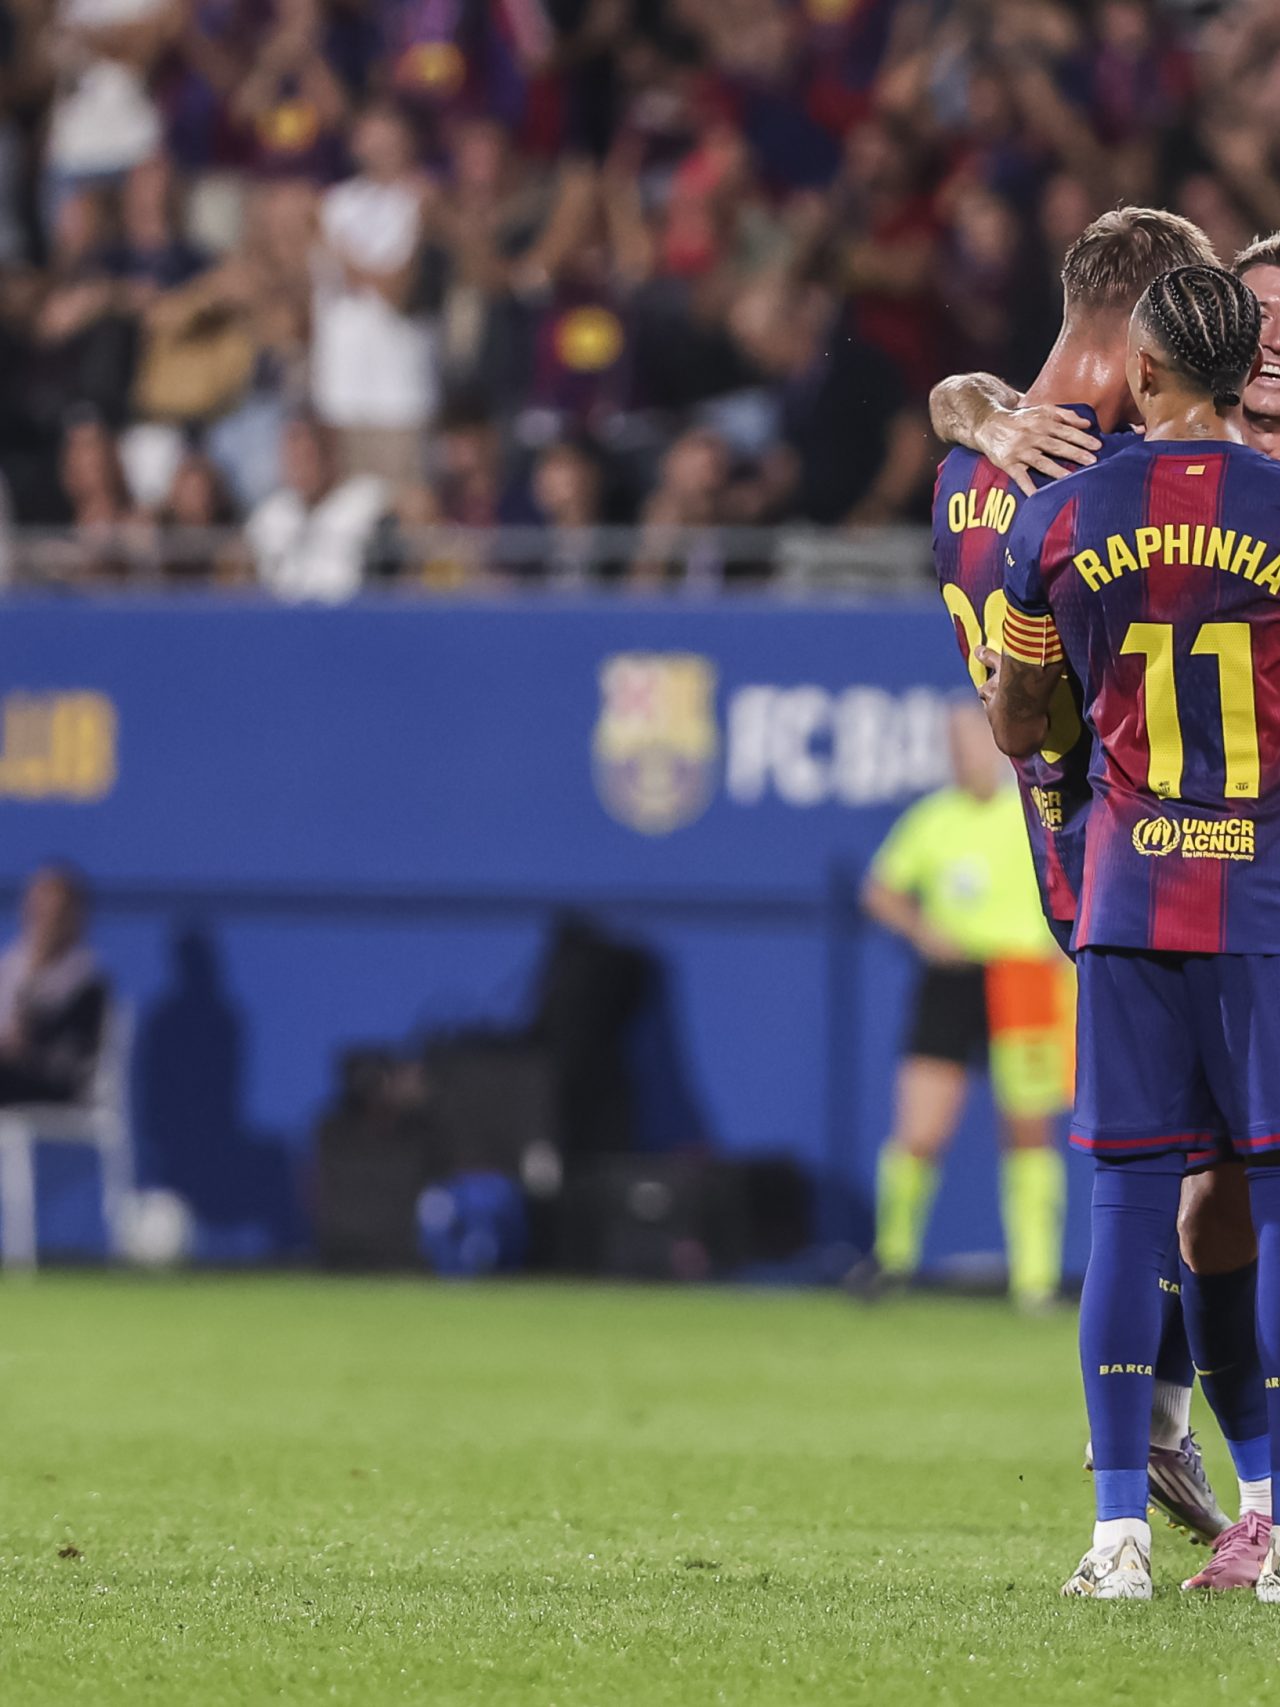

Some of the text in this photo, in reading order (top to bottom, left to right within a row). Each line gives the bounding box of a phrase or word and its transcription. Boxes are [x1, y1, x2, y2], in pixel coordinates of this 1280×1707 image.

[948, 487, 1016, 535] OLMO
[1119, 622, 1260, 798] 11
[1182, 818, 1255, 836] UNHCR
[1182, 834, 1255, 854] ACNUR
